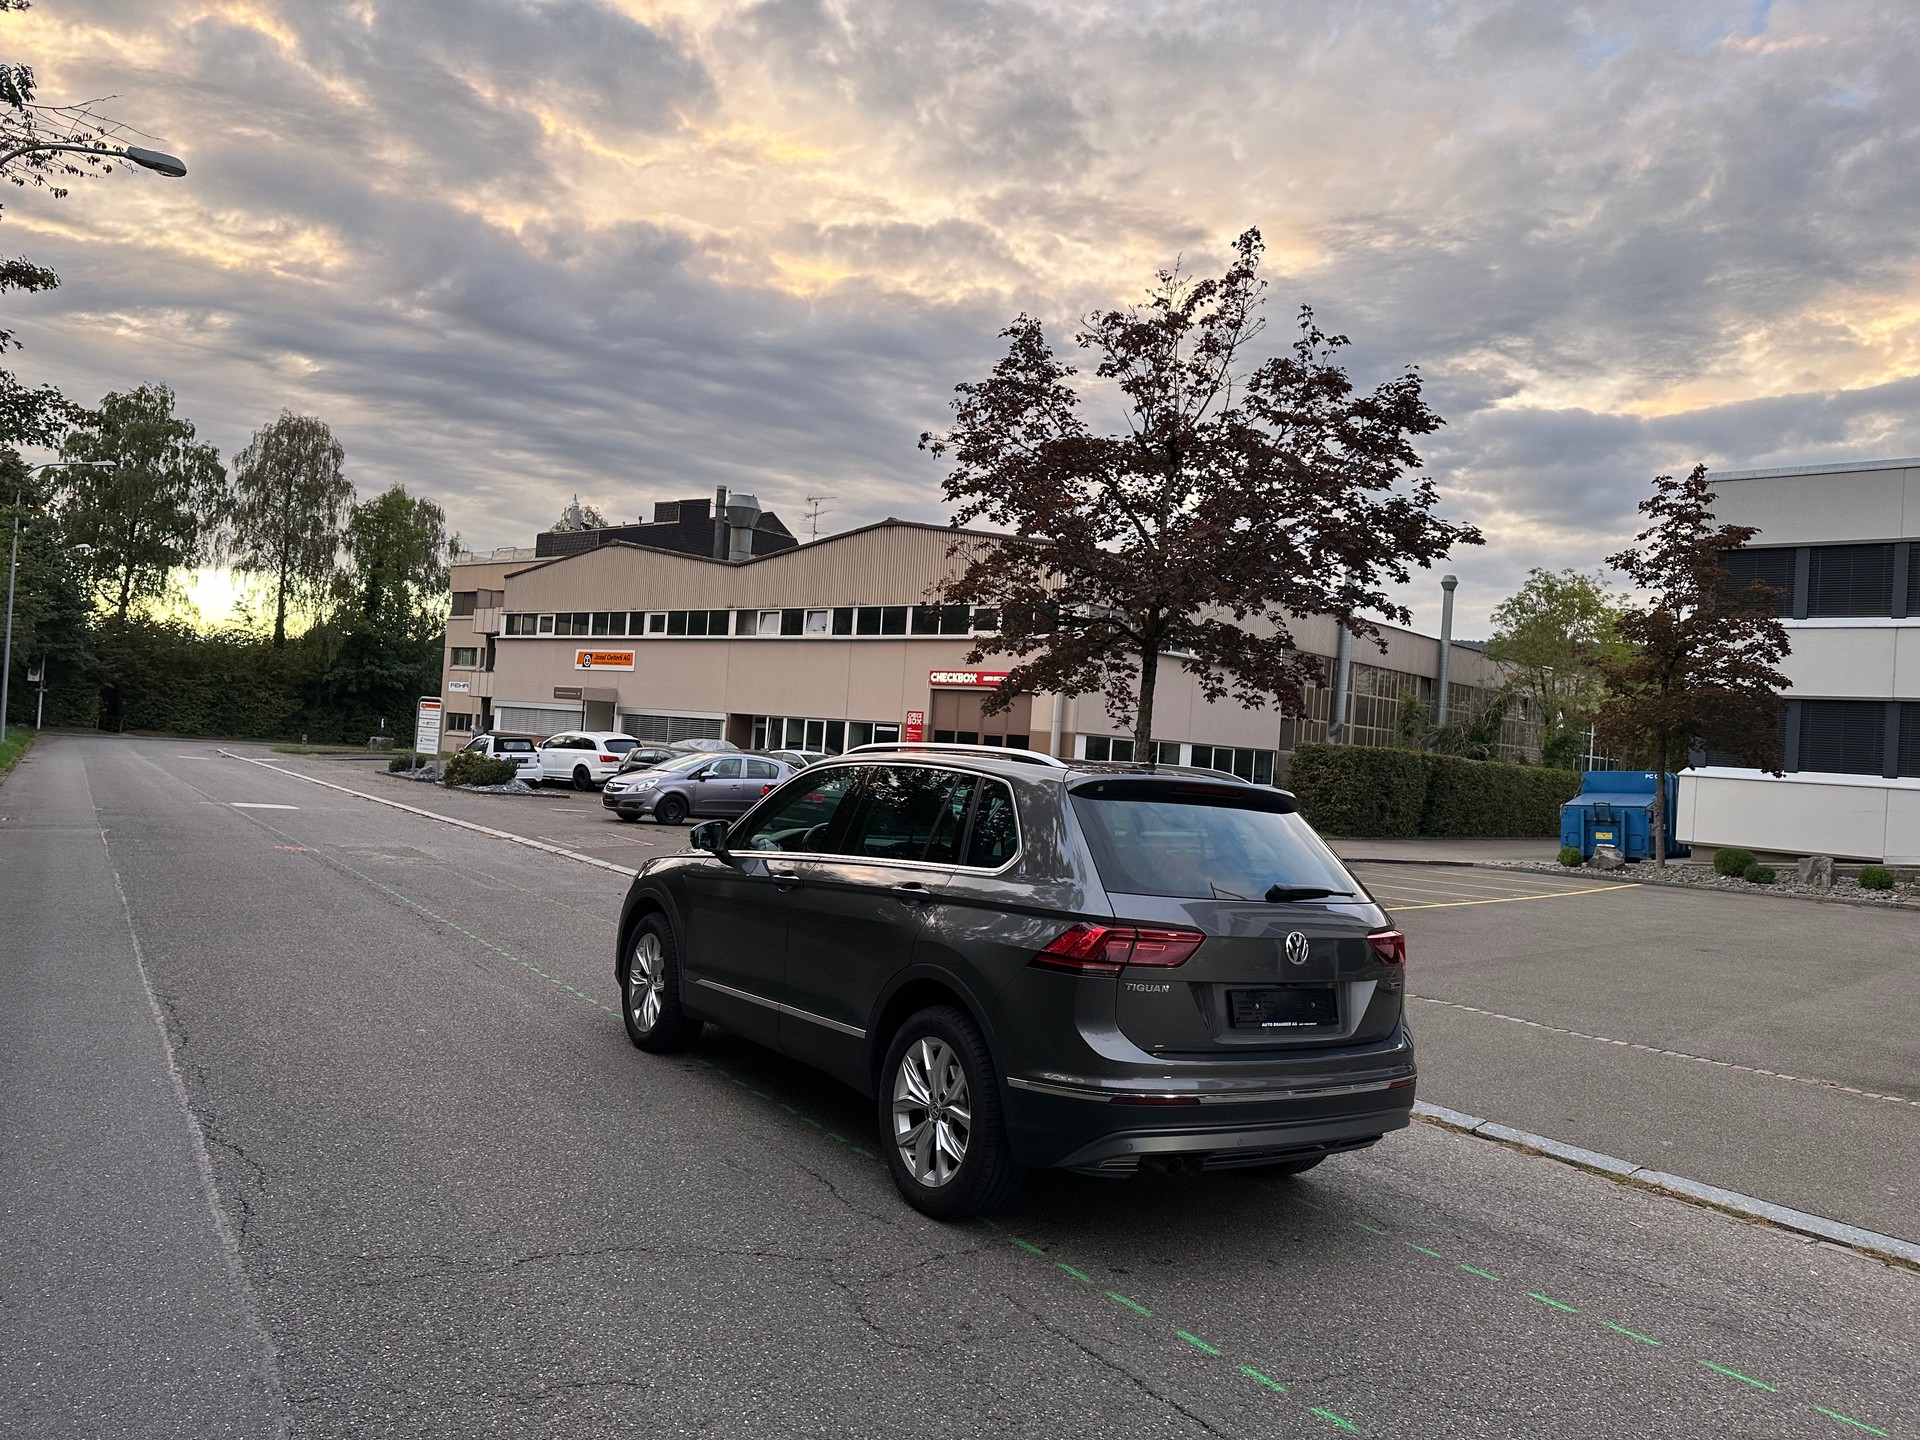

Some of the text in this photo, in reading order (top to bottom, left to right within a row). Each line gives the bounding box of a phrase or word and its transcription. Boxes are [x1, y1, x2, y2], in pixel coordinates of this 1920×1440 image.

[930, 672, 978, 683] CHECKBOX
[907, 717, 922, 726] BOX
[1125, 982, 1170, 993] TIGUAN
